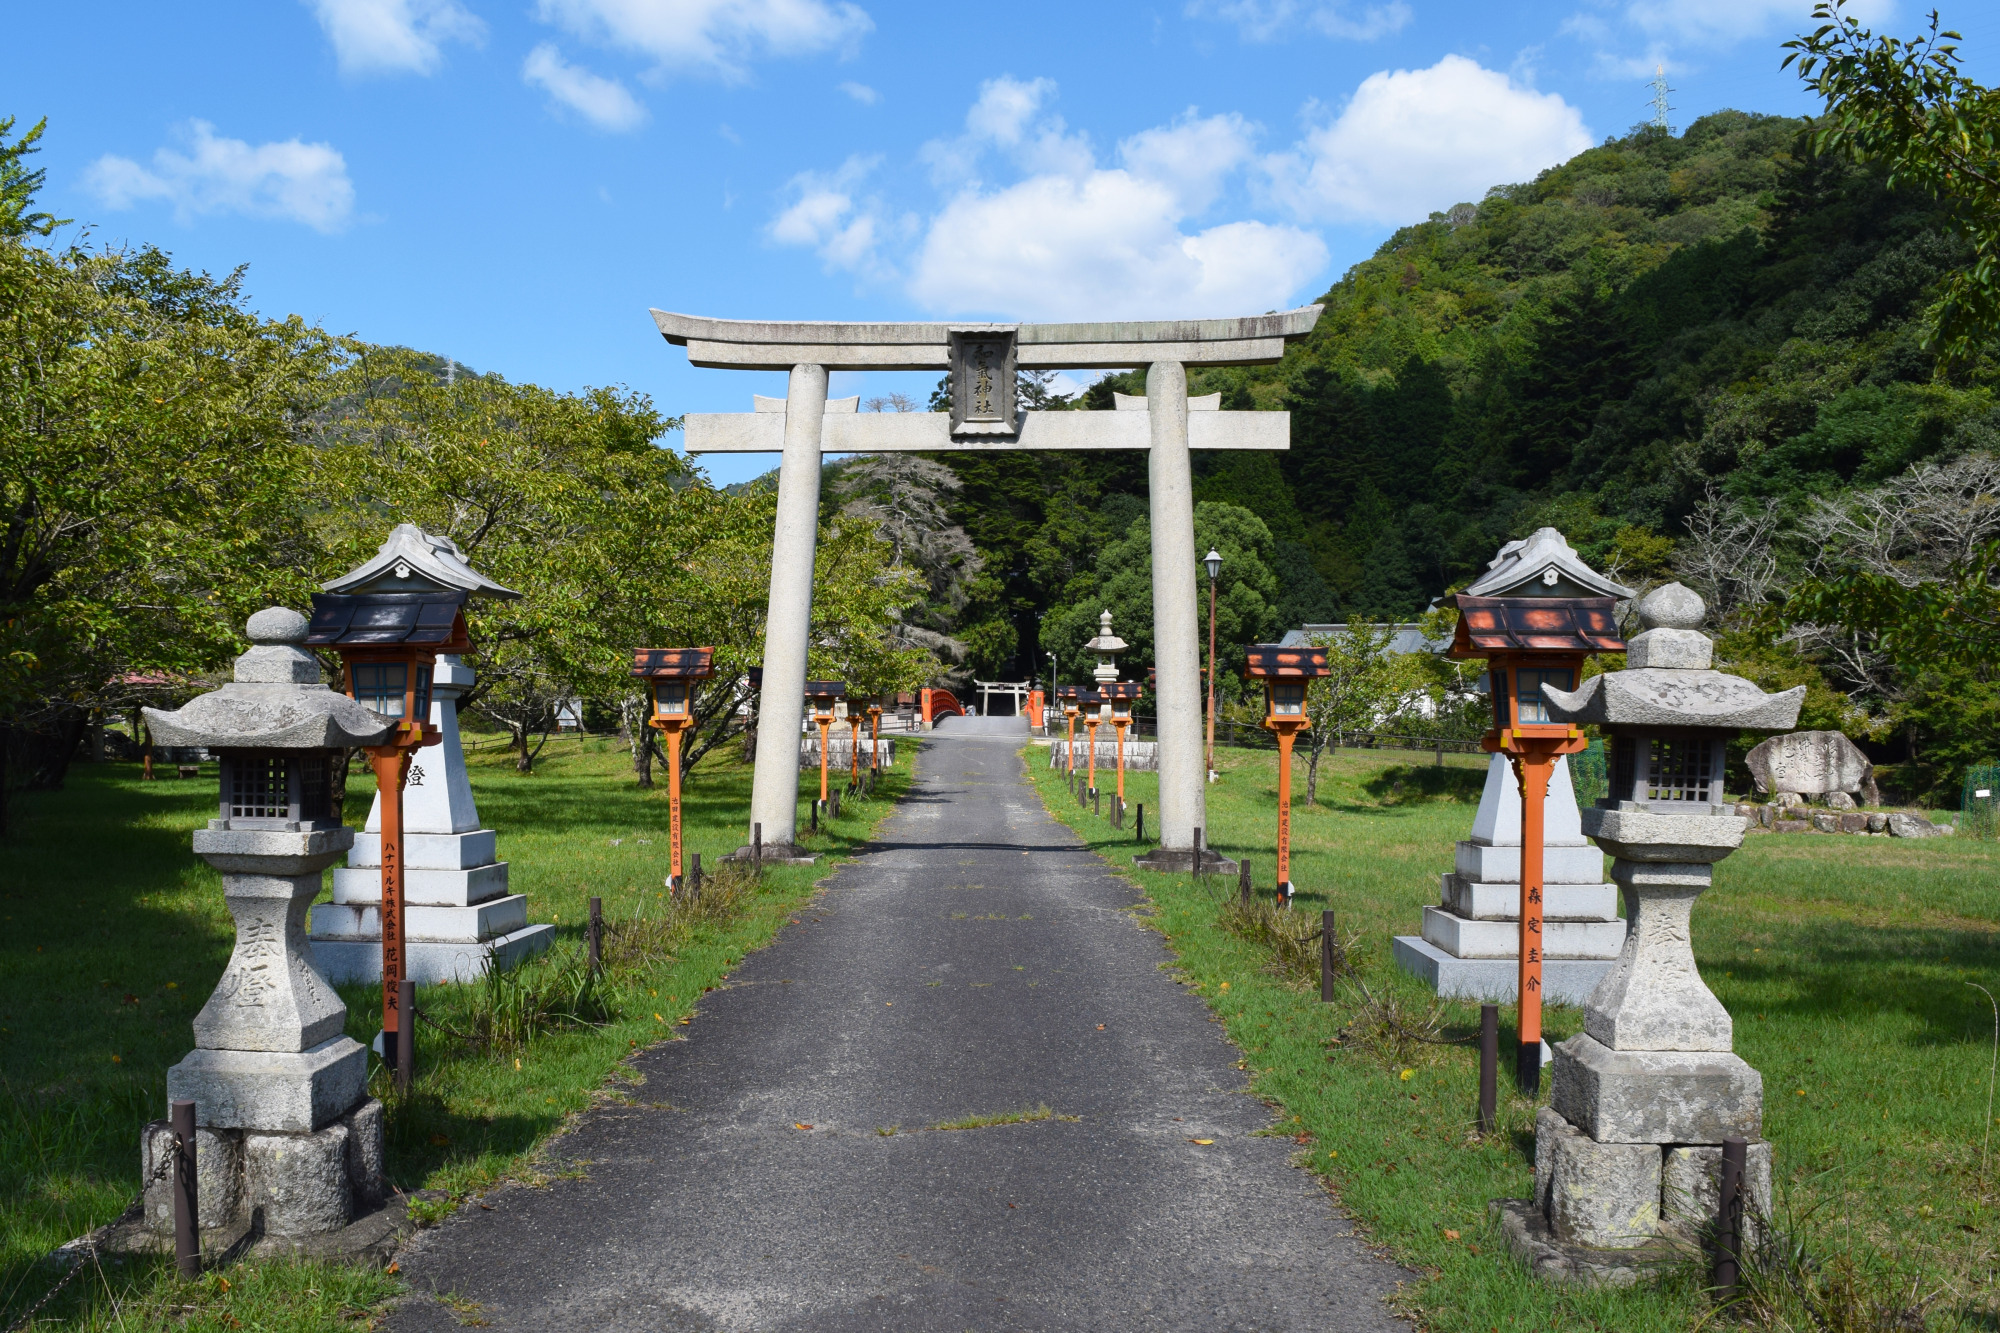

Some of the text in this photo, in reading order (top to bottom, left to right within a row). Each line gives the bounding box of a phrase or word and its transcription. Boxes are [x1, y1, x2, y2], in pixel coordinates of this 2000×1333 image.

[973, 344, 995, 414] 和氣神社
[671, 796, 679, 867] 池田建設有限会社
[1281, 801, 1289, 871] 池田建設有限会社
[385, 842, 399, 1010] ハナマルキ株式会社 花岡俊夫
[1526, 886, 1542, 992] 森定圭介
